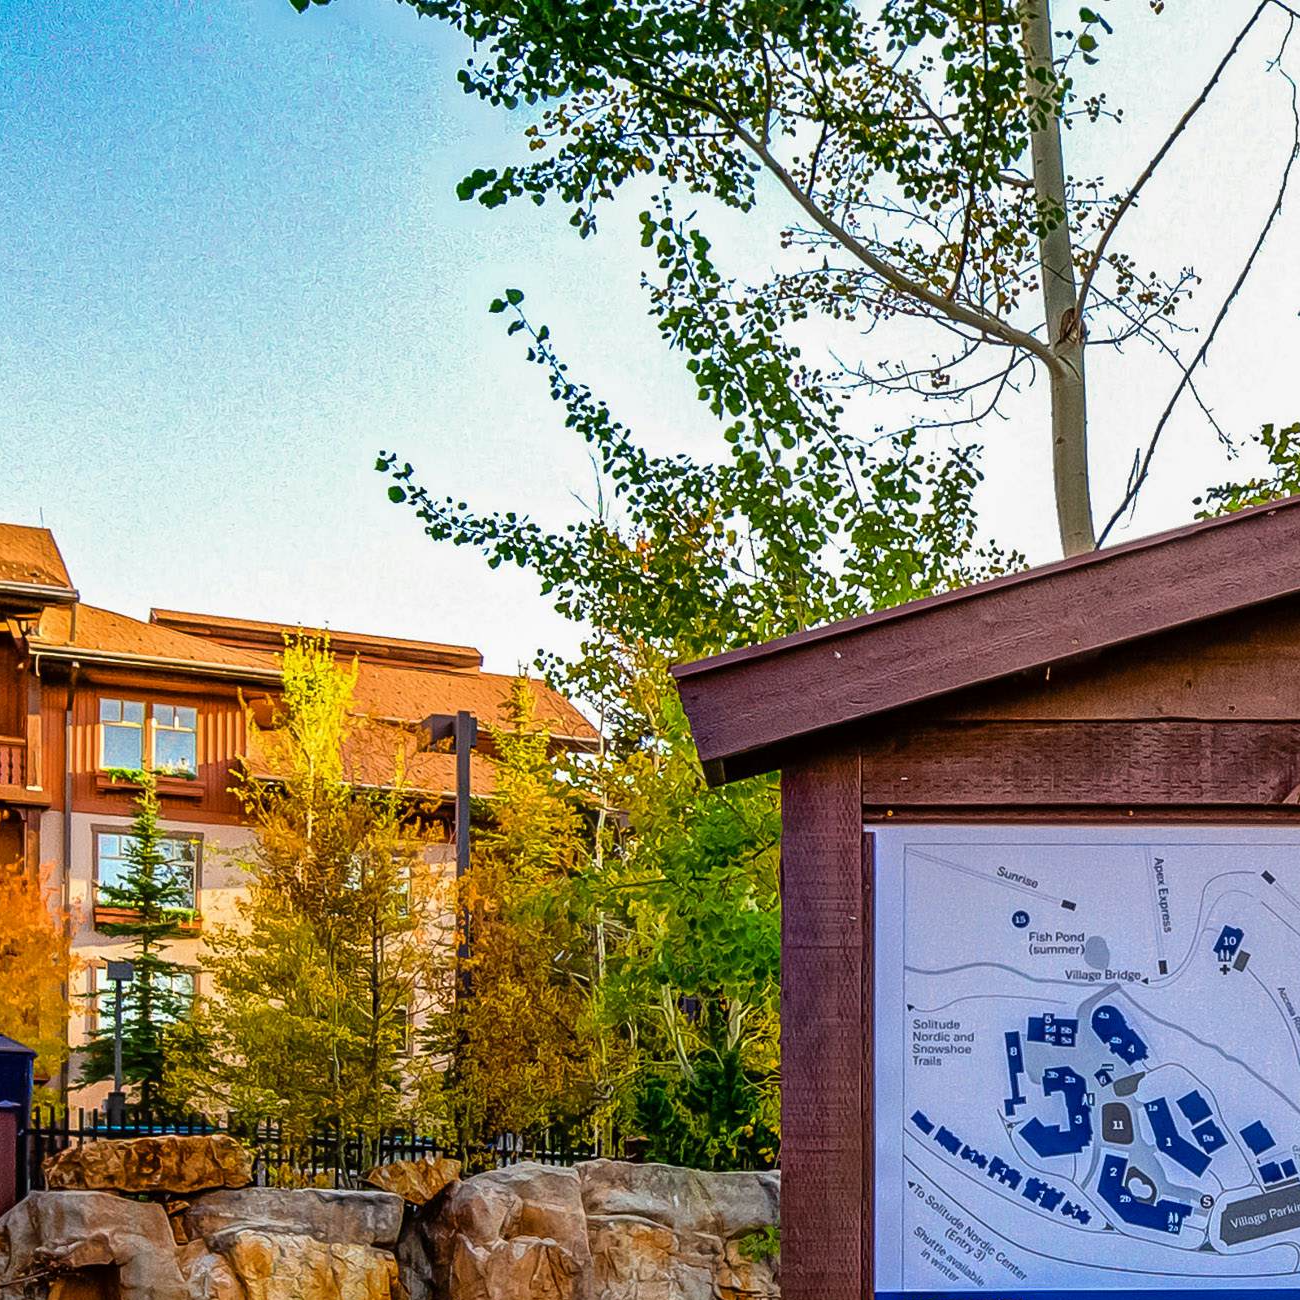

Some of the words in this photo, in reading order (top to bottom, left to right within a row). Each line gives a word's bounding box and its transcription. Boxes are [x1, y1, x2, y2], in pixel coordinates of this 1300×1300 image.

[996, 866, 1039, 888] Sunrise
[1154, 857, 1166, 886] Apex
[1158, 888, 1172, 932] Express
[1016, 916, 1026, 924] 15
[1029, 932, 1052, 942] Fish
[1056, 932, 1084, 942] Pond
[1224, 936, 1236, 946] 10
[1028, 944, 1086, 956] (summer)
[1065, 970, 1101, 981] Village
[1104, 970, 1142, 981] Bridge
[912, 1020, 960, 1030] Solitude
[912, 1032, 950, 1042] Nordic
[954, 1032, 974, 1042] and
[912, 1044, 972, 1054] Snowshoe
[912, 1056, 942, 1066] Trails
[1112, 1120, 1124, 1130] 11
[1230, 1210, 1268, 1230] Village
[913, 1184, 926, 1199] To
[924, 1194, 964, 1233] Solitude
[964, 1226, 996, 1257] Nordic
[995, 1252, 1027, 1282] Center
[944, 1228, 978, 1257] (Entry
[914, 1226, 946, 1257] Shuttle
[946, 1254, 985, 1287] available
[928, 1254, 960, 1282] winter
